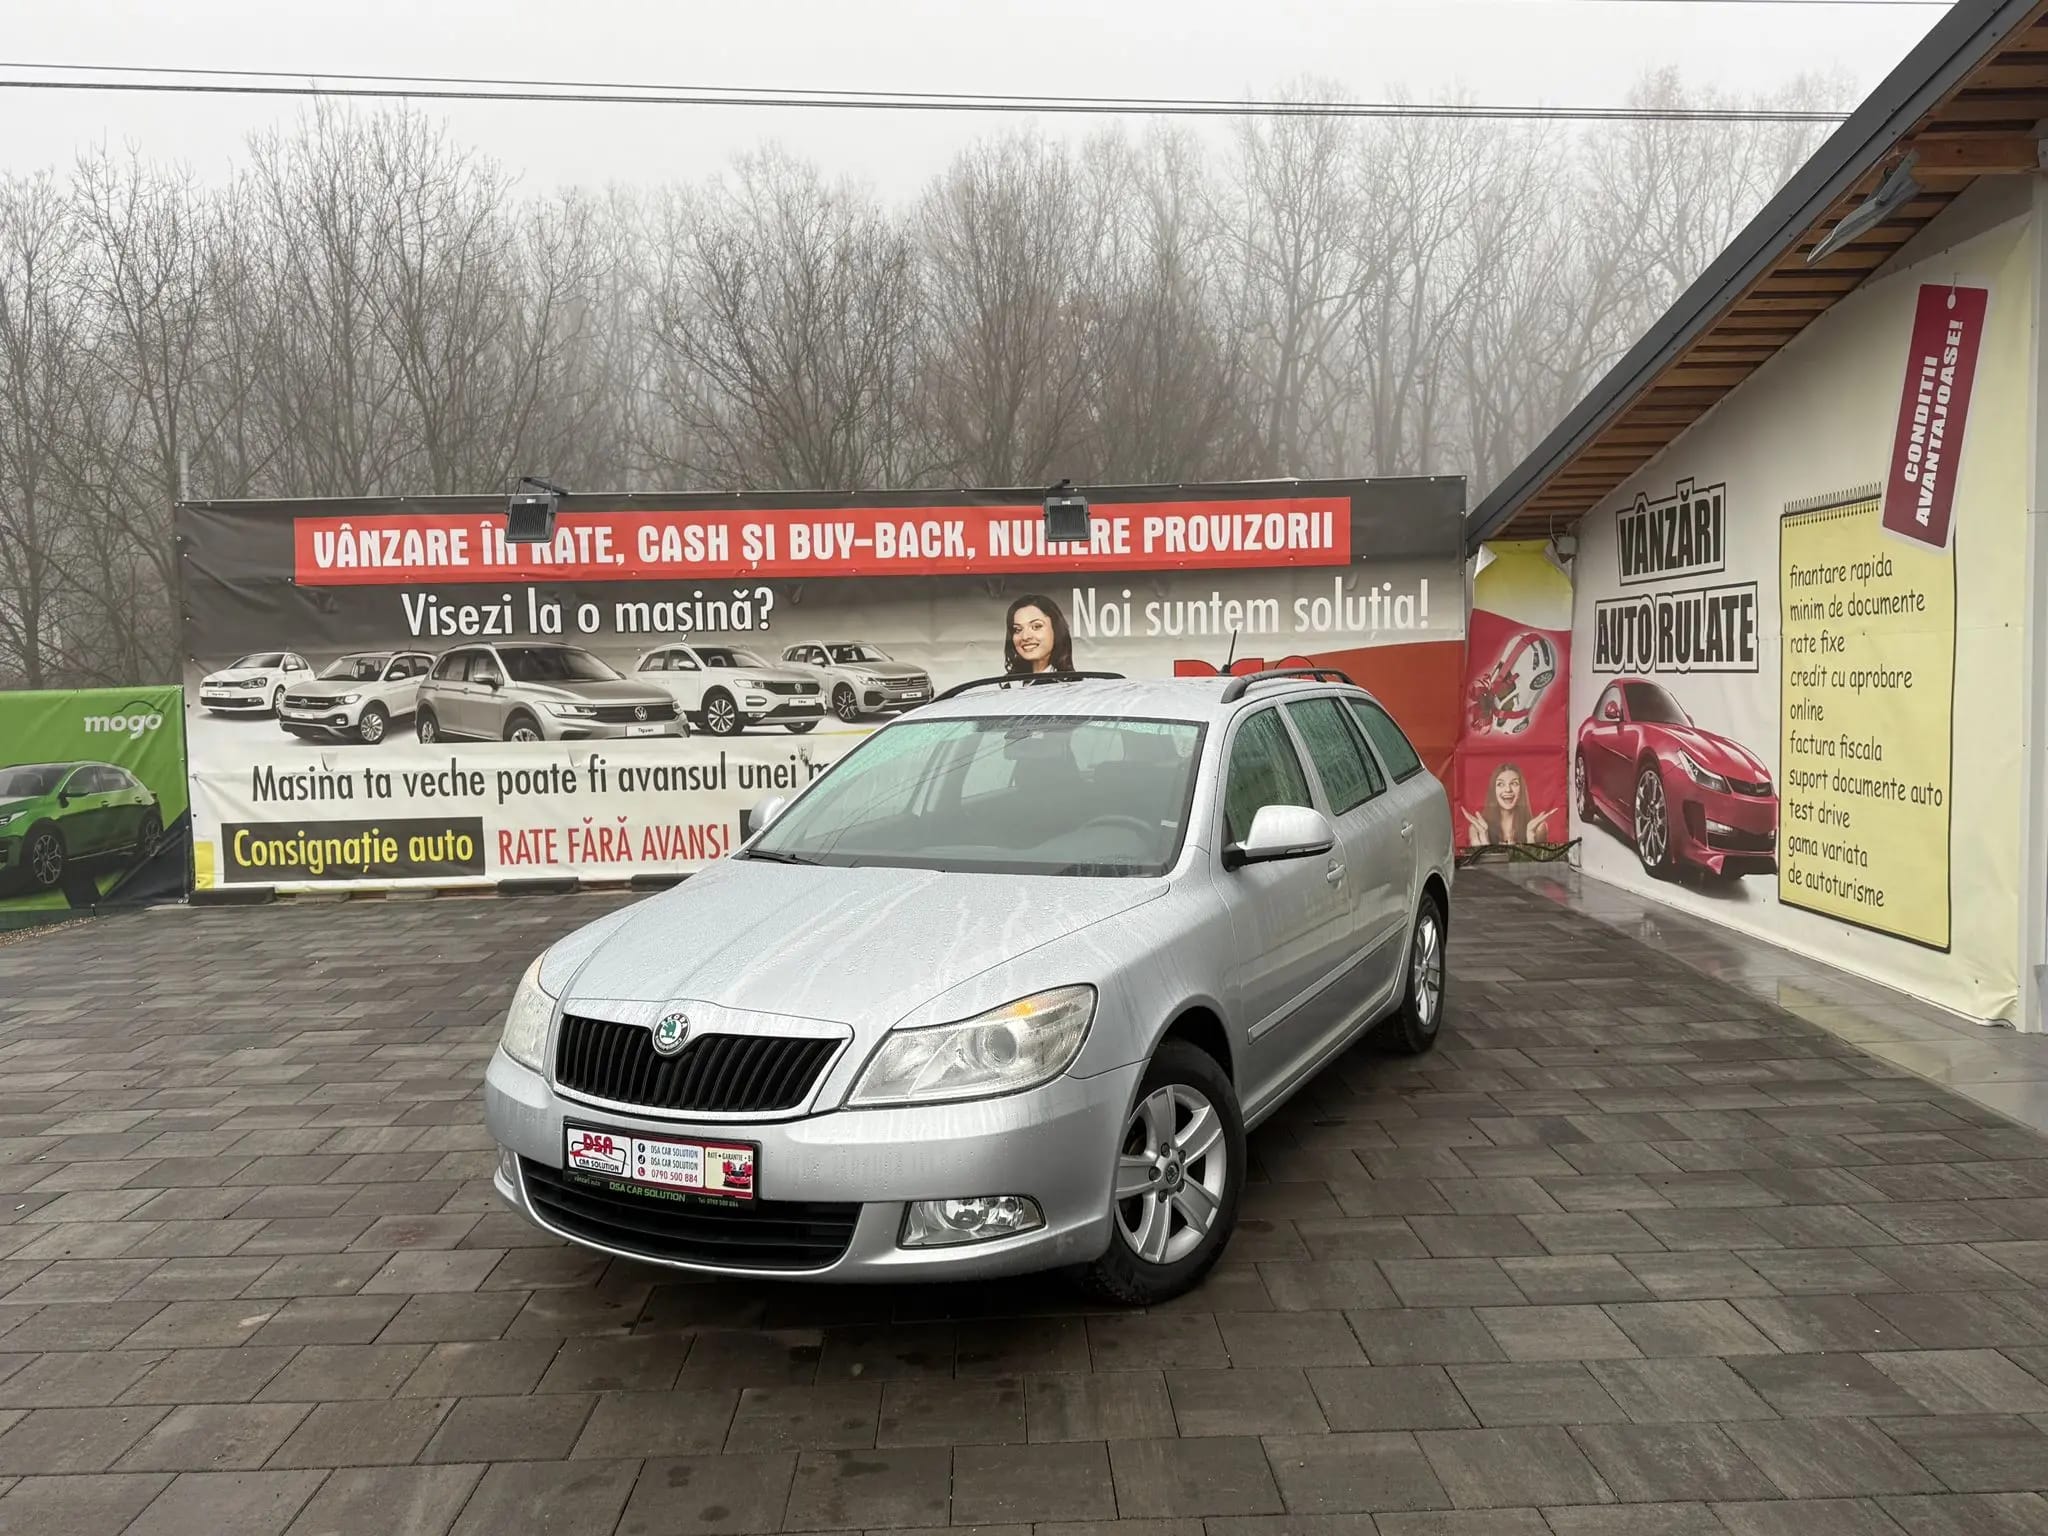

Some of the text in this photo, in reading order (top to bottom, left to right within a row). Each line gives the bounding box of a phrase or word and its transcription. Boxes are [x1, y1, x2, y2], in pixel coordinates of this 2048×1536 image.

[1904, 355, 1938, 483] CONDITII
[1915, 320, 1963, 527] AVANTAJOASE!
[313, 522, 469, 568] VÂNZARE
[638, 524, 729, 562] CASH
[742, 523, 776, 569] ȘI
[789, 520, 976, 560] BUY-BACK,
[1144, 512, 1333, 554] PROVIZORII
[1620, 489, 1720, 576] VÂNZĂRI
[1790, 552, 1893, 589] finantare rapida
[401, 586, 774, 642] Visezi la o mașină?
[1072, 576, 1429, 640] Noi suntem soluția!
[1790, 589, 1925, 621] minim de documente
[1596, 593, 1753, 665] AUTO RULATE
[1790, 629, 1845, 654] rate fixe
[1790, 664, 1913, 695] credit cu aprobare
[84, 713, 163, 739] mogo
[1790, 697, 1824, 721] online
[1790, 730, 1882, 761] factura fiscala
[252, 765, 354, 801] Masina
[364, 767, 392, 798] ta
[402, 757, 485, 797] veche
[497, 763, 577, 805] poate
[588, 753, 607, 792] fi
[618, 751, 727, 792] avansul
[738, 754, 797, 790] unei
[1789, 768, 1943, 807] suport documente auto
[1789, 798, 1850, 828] test drive
[234, 828, 473, 874] Consignație auto
[498, 815, 729, 866] RATE FĂRĂ AVANS!
[1788, 834, 1868, 868] gama variata
[1788, 862, 1884, 907] de autoturisme
[583, 1133, 613, 1155] DSA
[662, 1147, 671, 1155] CAR
[673, 1148, 698, 1158] SOLUTION
[591, 1161, 619, 1172] SOLUTION
[651, 1169, 697, 1184] 0790 500 884
[662, 1159, 671, 1167] CAR
[673, 1160, 698, 1170] SOLUTION
[609, 1182, 686, 1202] DSA CAR SOLUTION
